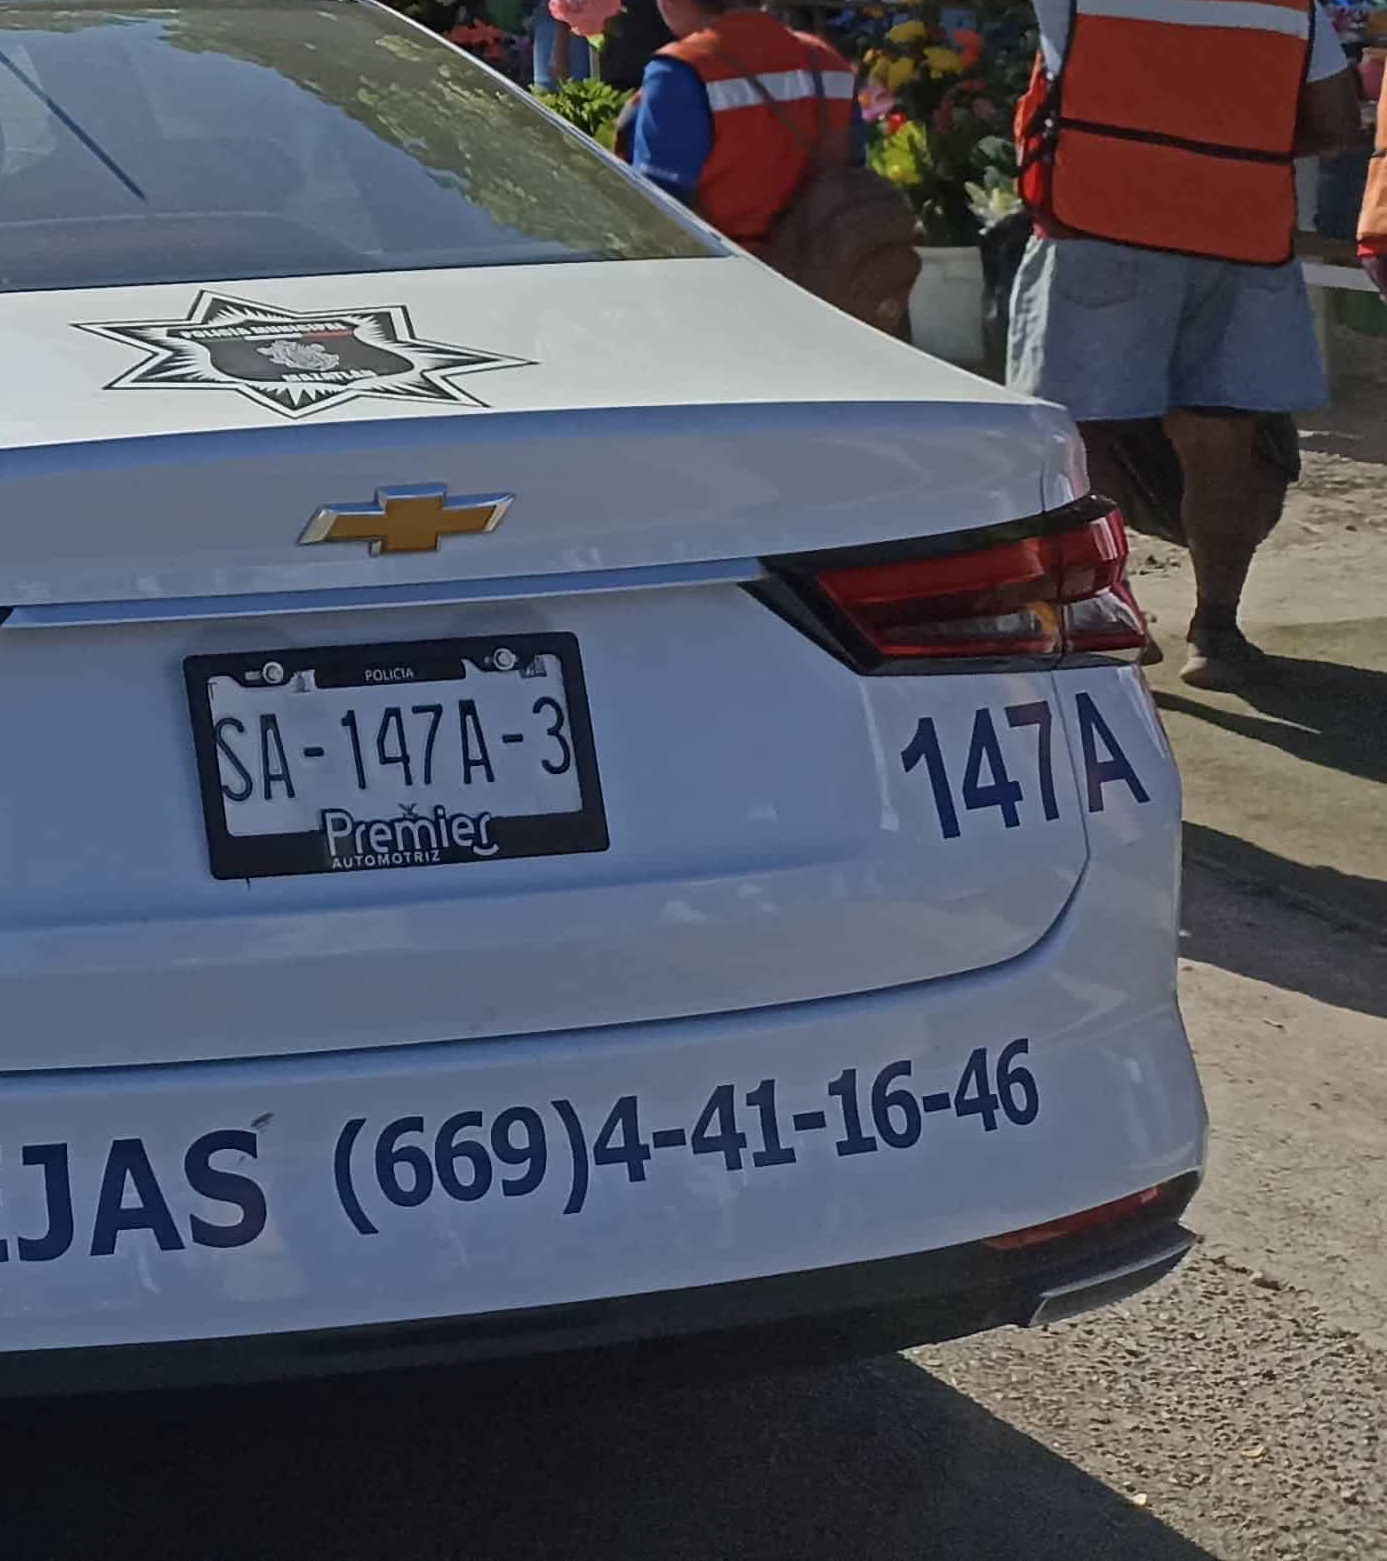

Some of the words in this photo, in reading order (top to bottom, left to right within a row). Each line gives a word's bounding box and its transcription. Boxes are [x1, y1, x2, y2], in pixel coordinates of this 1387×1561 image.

[213, 696, 572, 802] SA-147A-3
[900, 690, 1151, 839] 147A
[324, 807, 499, 857] Premier
[332, 849, 441, 870] AUTOMOTRIZ
[332, 1039, 1042, 1237] (669)4-41-16-46
